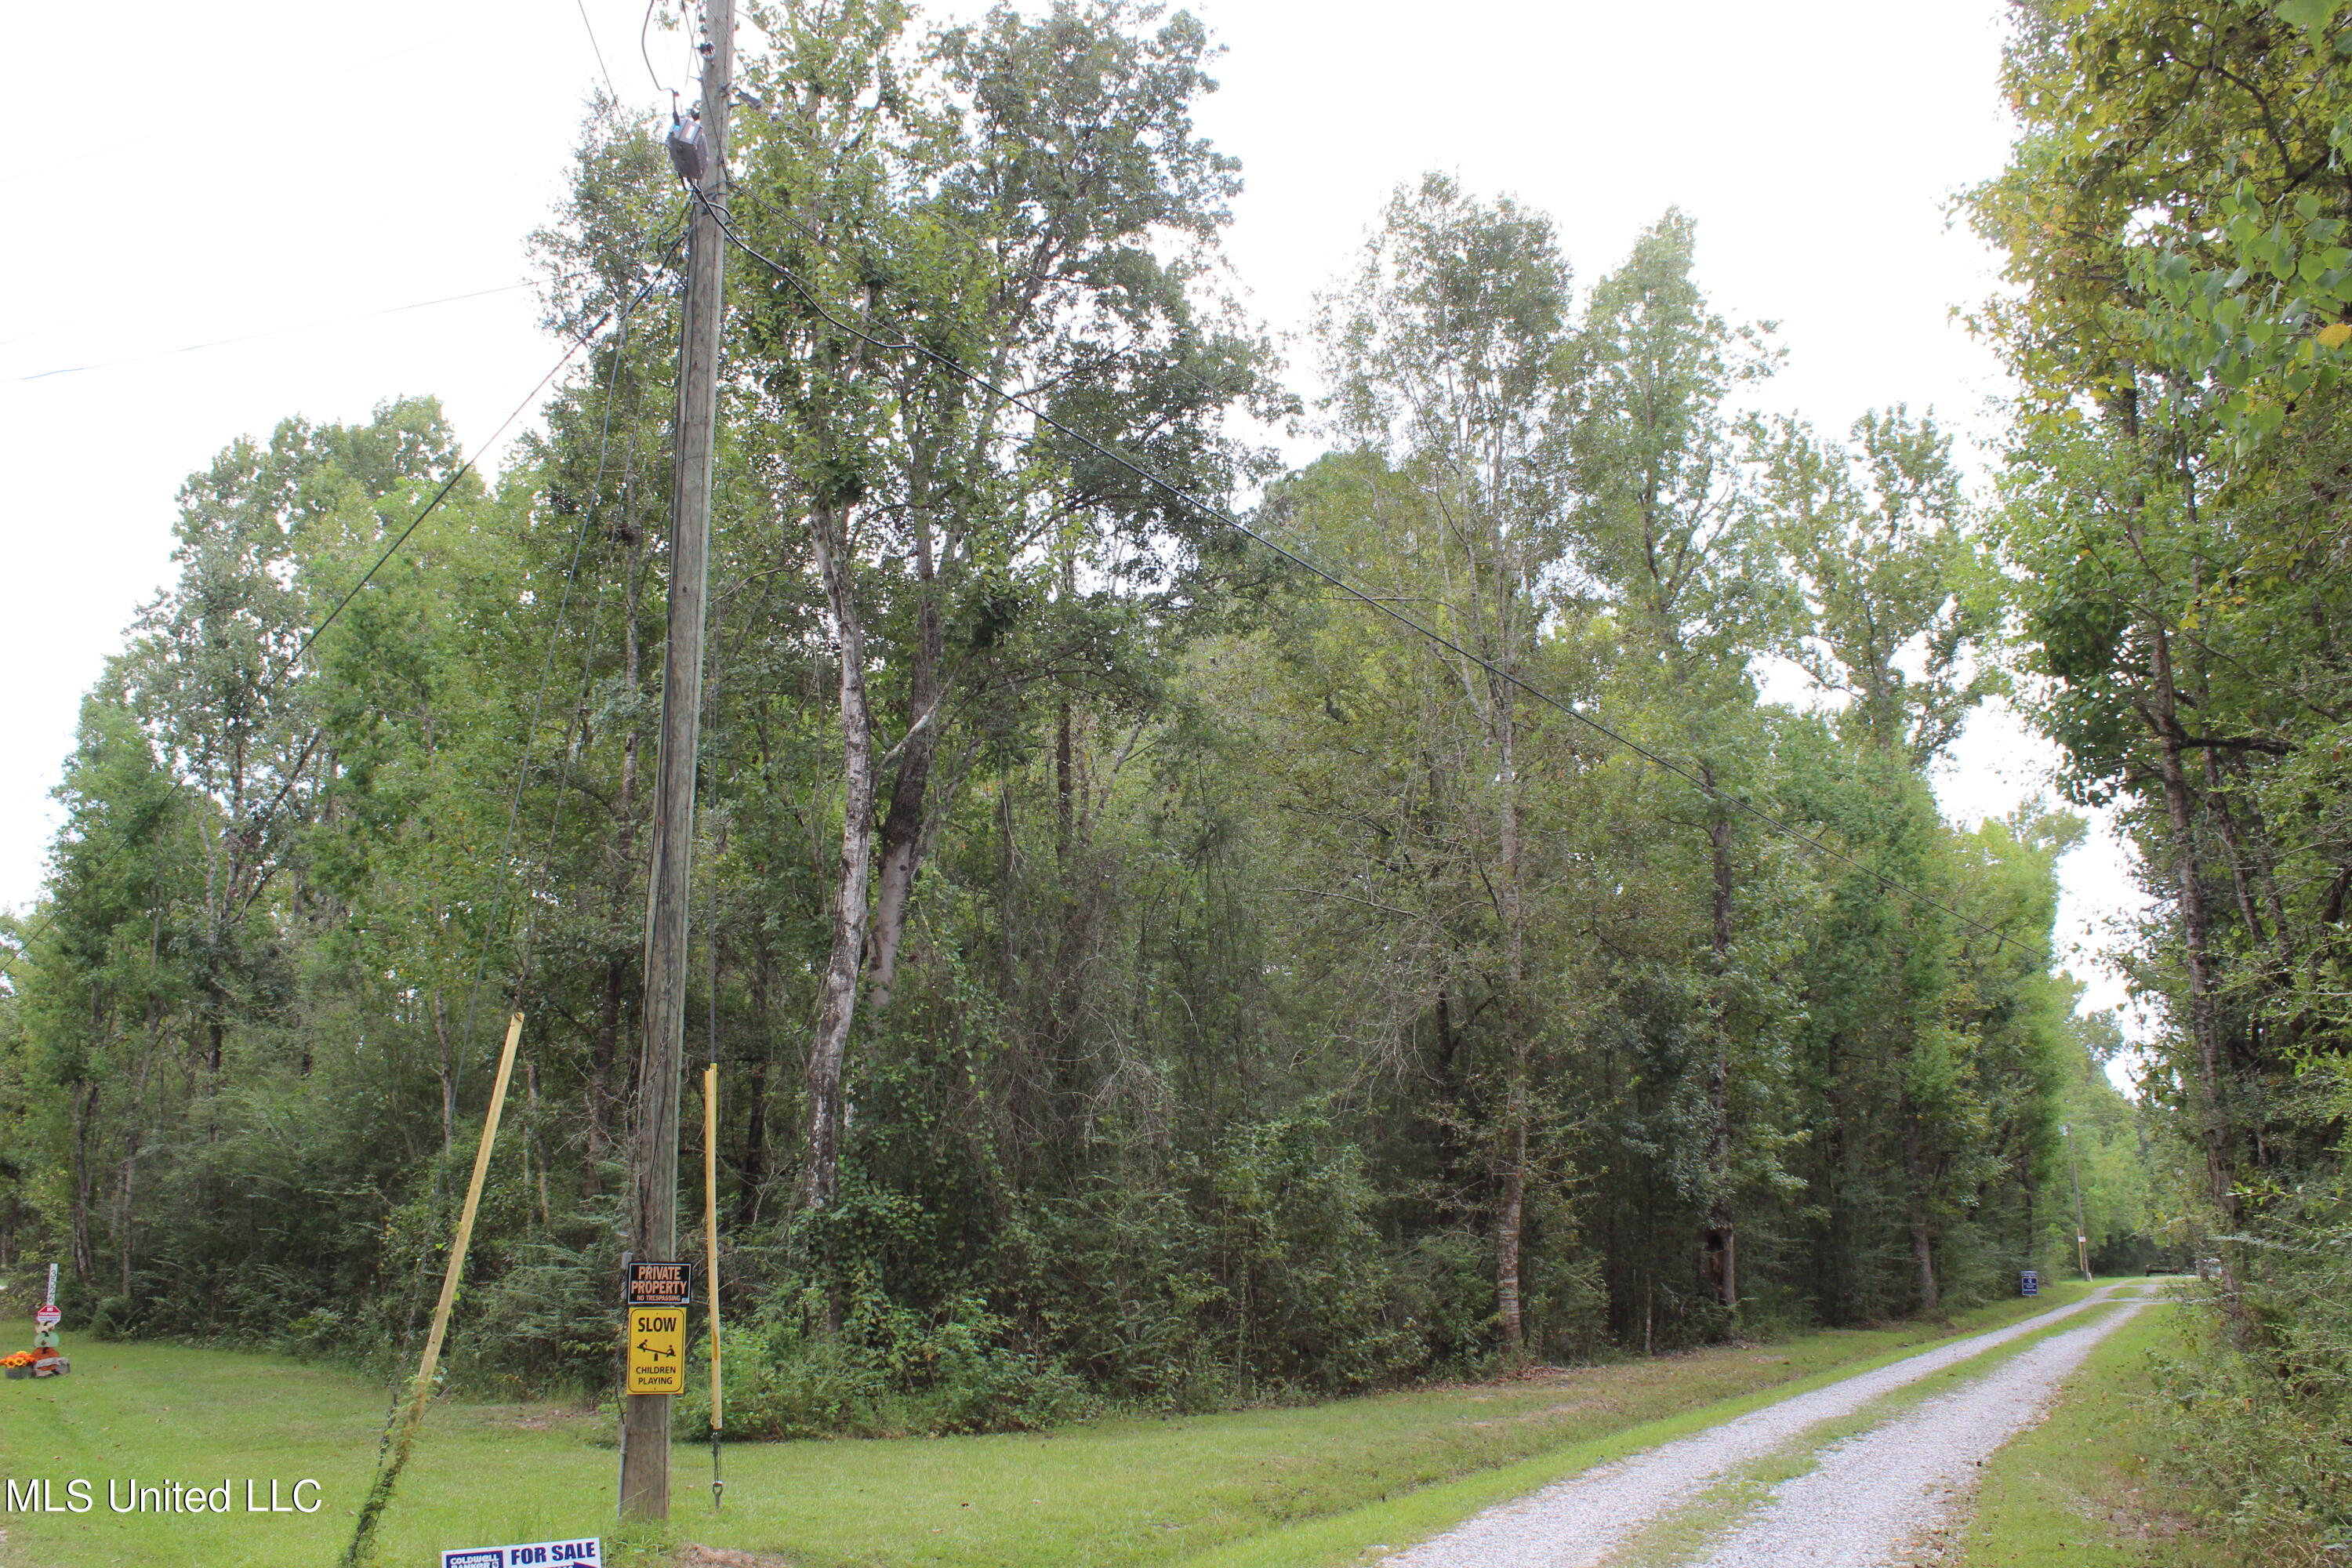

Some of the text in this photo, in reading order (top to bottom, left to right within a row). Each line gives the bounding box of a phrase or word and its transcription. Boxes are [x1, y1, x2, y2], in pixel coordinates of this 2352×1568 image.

[638, 1265, 681, 1280] PRIVATE
[631, 1280, 687, 1294] PROPERTY
[637, 1316, 677, 1332] SLOW
[636, 1366, 676, 1374] CHILDREN
[638, 1377, 673, 1385] PLAYING
[511, 1541, 596, 1565] FOR SALE
